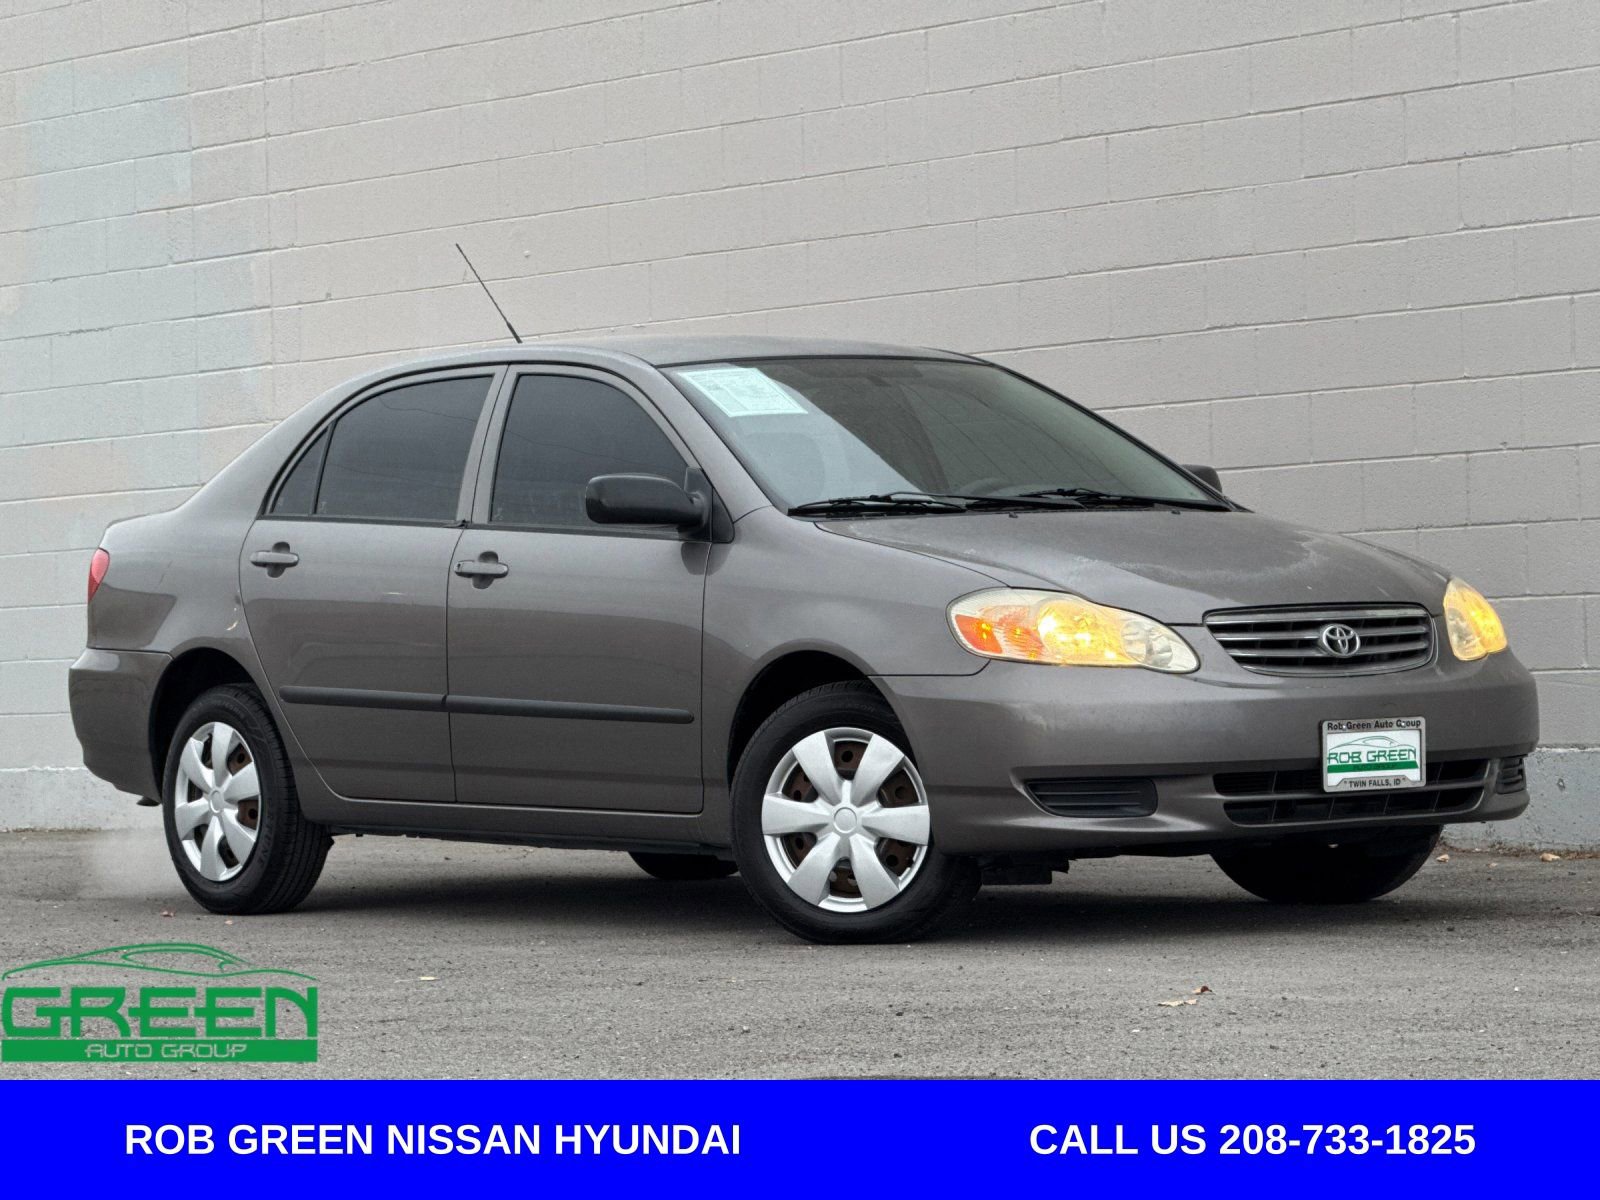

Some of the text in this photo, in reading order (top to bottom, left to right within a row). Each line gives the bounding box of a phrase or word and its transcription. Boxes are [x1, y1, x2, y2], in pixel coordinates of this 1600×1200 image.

[1327, 722, 1343, 731] Rob
[1346, 721, 1372, 730] Green
[1374, 720, 1394, 729] Auto
[1327, 748, 1417, 765] ROB GREEN
